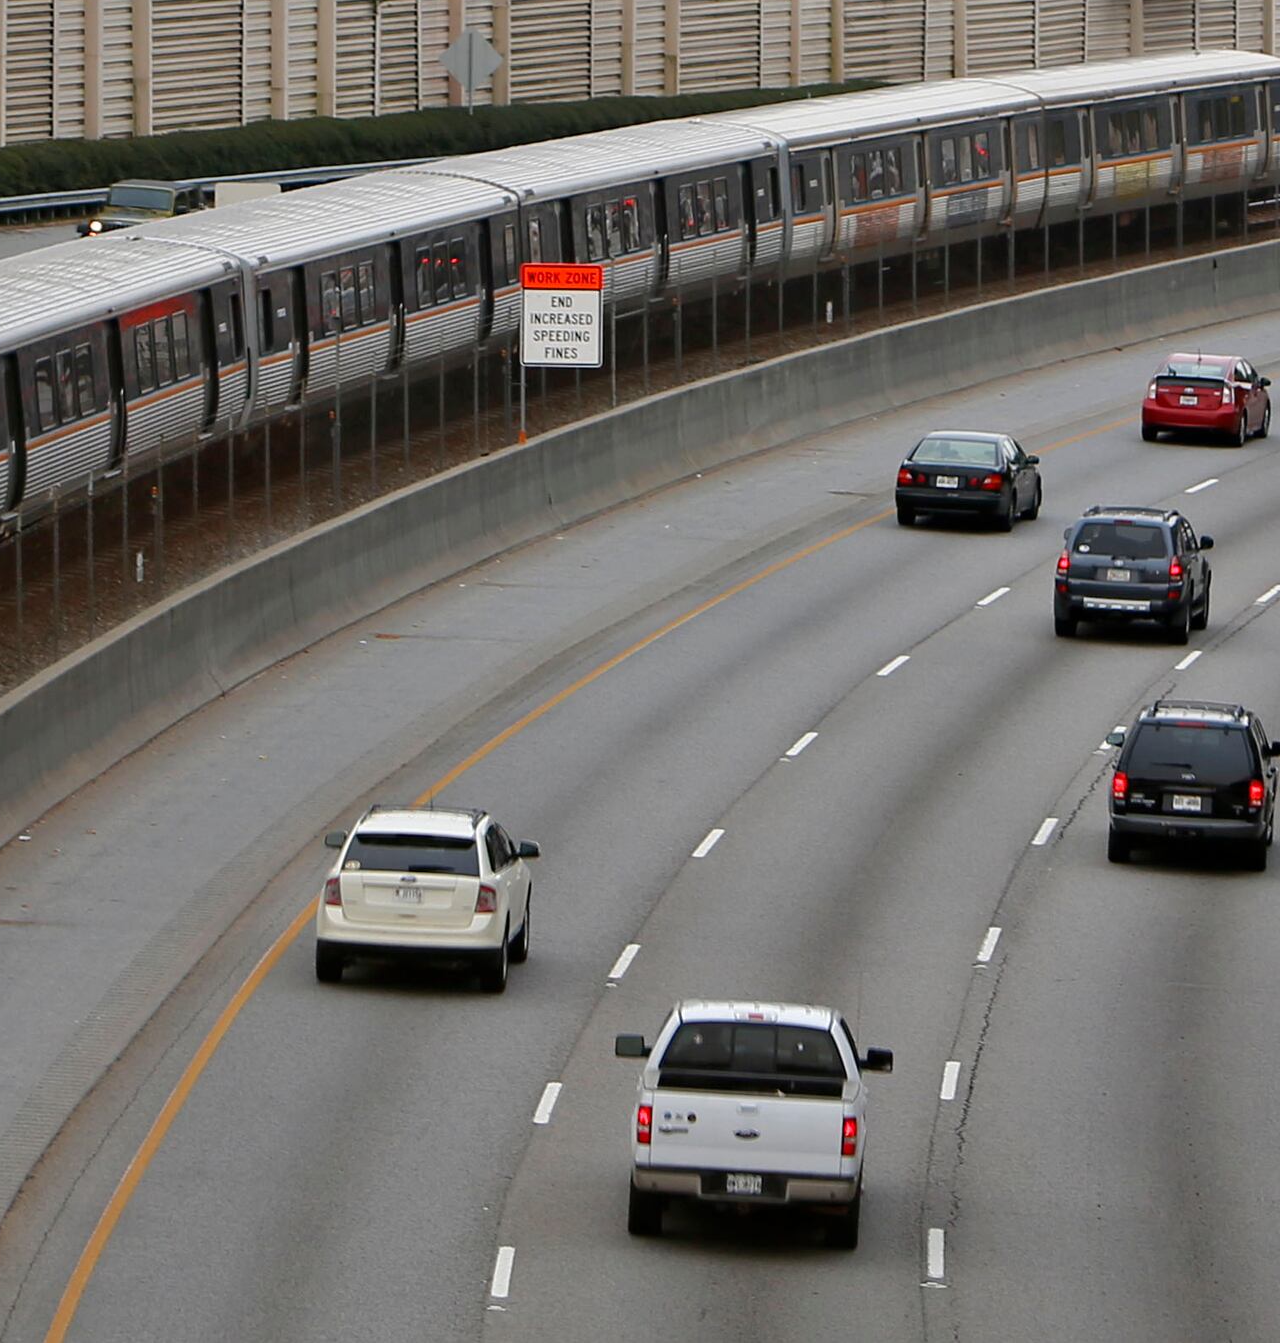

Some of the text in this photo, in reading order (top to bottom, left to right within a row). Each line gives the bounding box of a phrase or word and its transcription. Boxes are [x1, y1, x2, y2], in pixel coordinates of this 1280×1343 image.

[527, 272, 597, 284] WORK ZONE
[551, 296, 573, 307] END
[530, 313, 593, 325] INCREASED
[533, 330, 590, 342] SPEEDING
[544, 347, 578, 359] FINES
